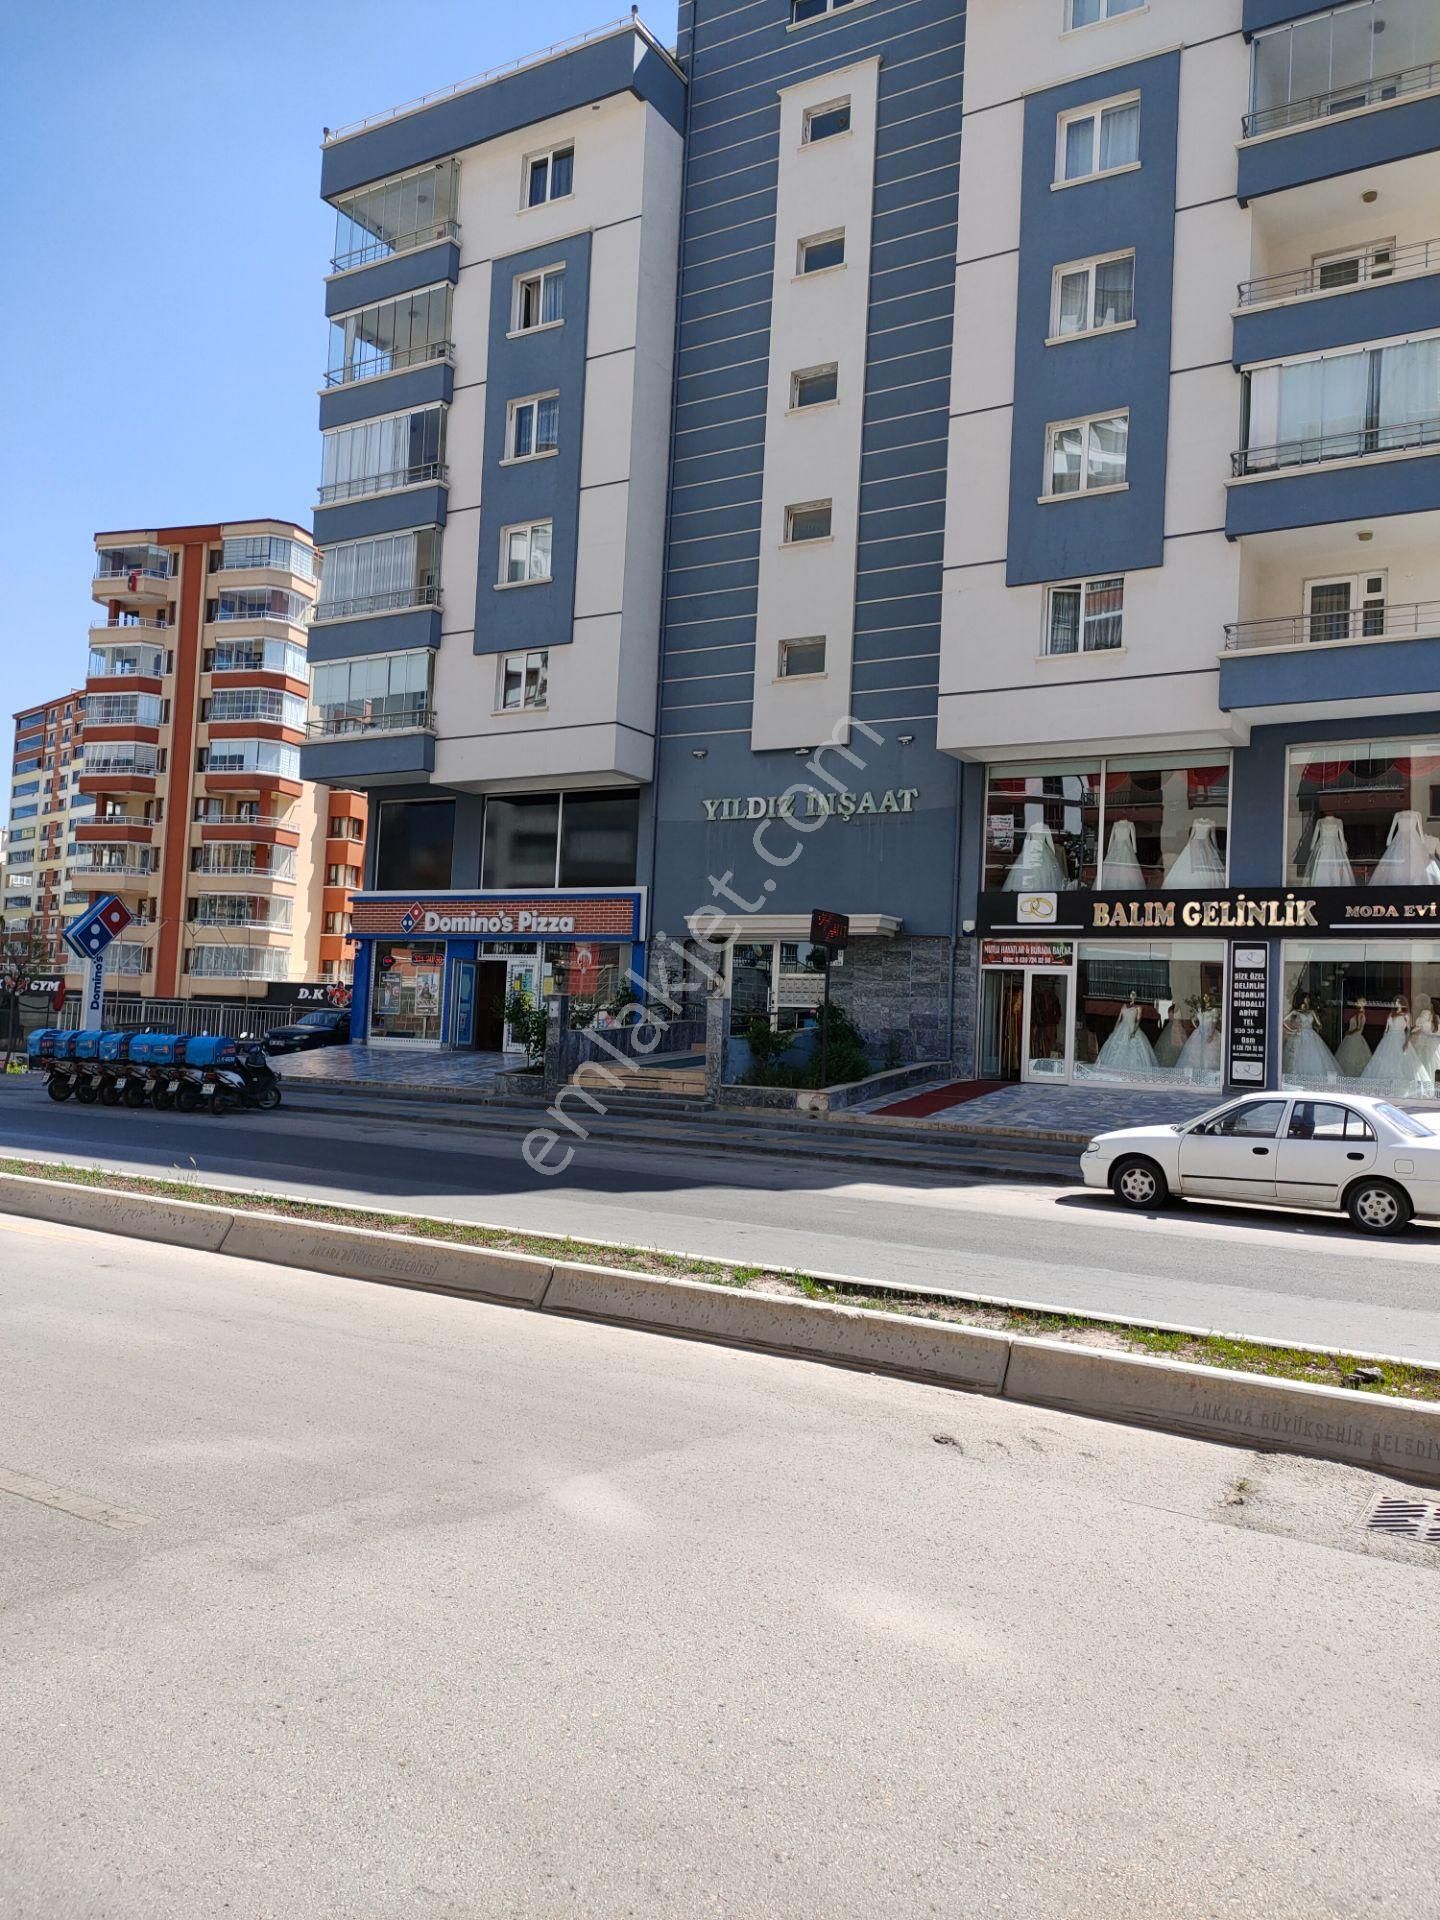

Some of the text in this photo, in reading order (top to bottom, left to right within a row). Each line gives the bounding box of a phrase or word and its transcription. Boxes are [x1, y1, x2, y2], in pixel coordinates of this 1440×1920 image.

[702, 787, 919, 822] YILDIZ İNŞAAT
[424, 909, 575, 933] Domino's Pizza
[1092, 893, 1318, 928] BALIM GELİNLİK
[1345, 901, 1437, 918] MODA EVİ
[30, 980, 60, 992] GYM
[90, 955, 103, 1010] Domino's
[297, 988, 325, 1000] D.K
[1191, 1401, 1254, 1427] ANKARA
[1261, 1411, 1364, 1448] BÜYÜKŞEHİR
